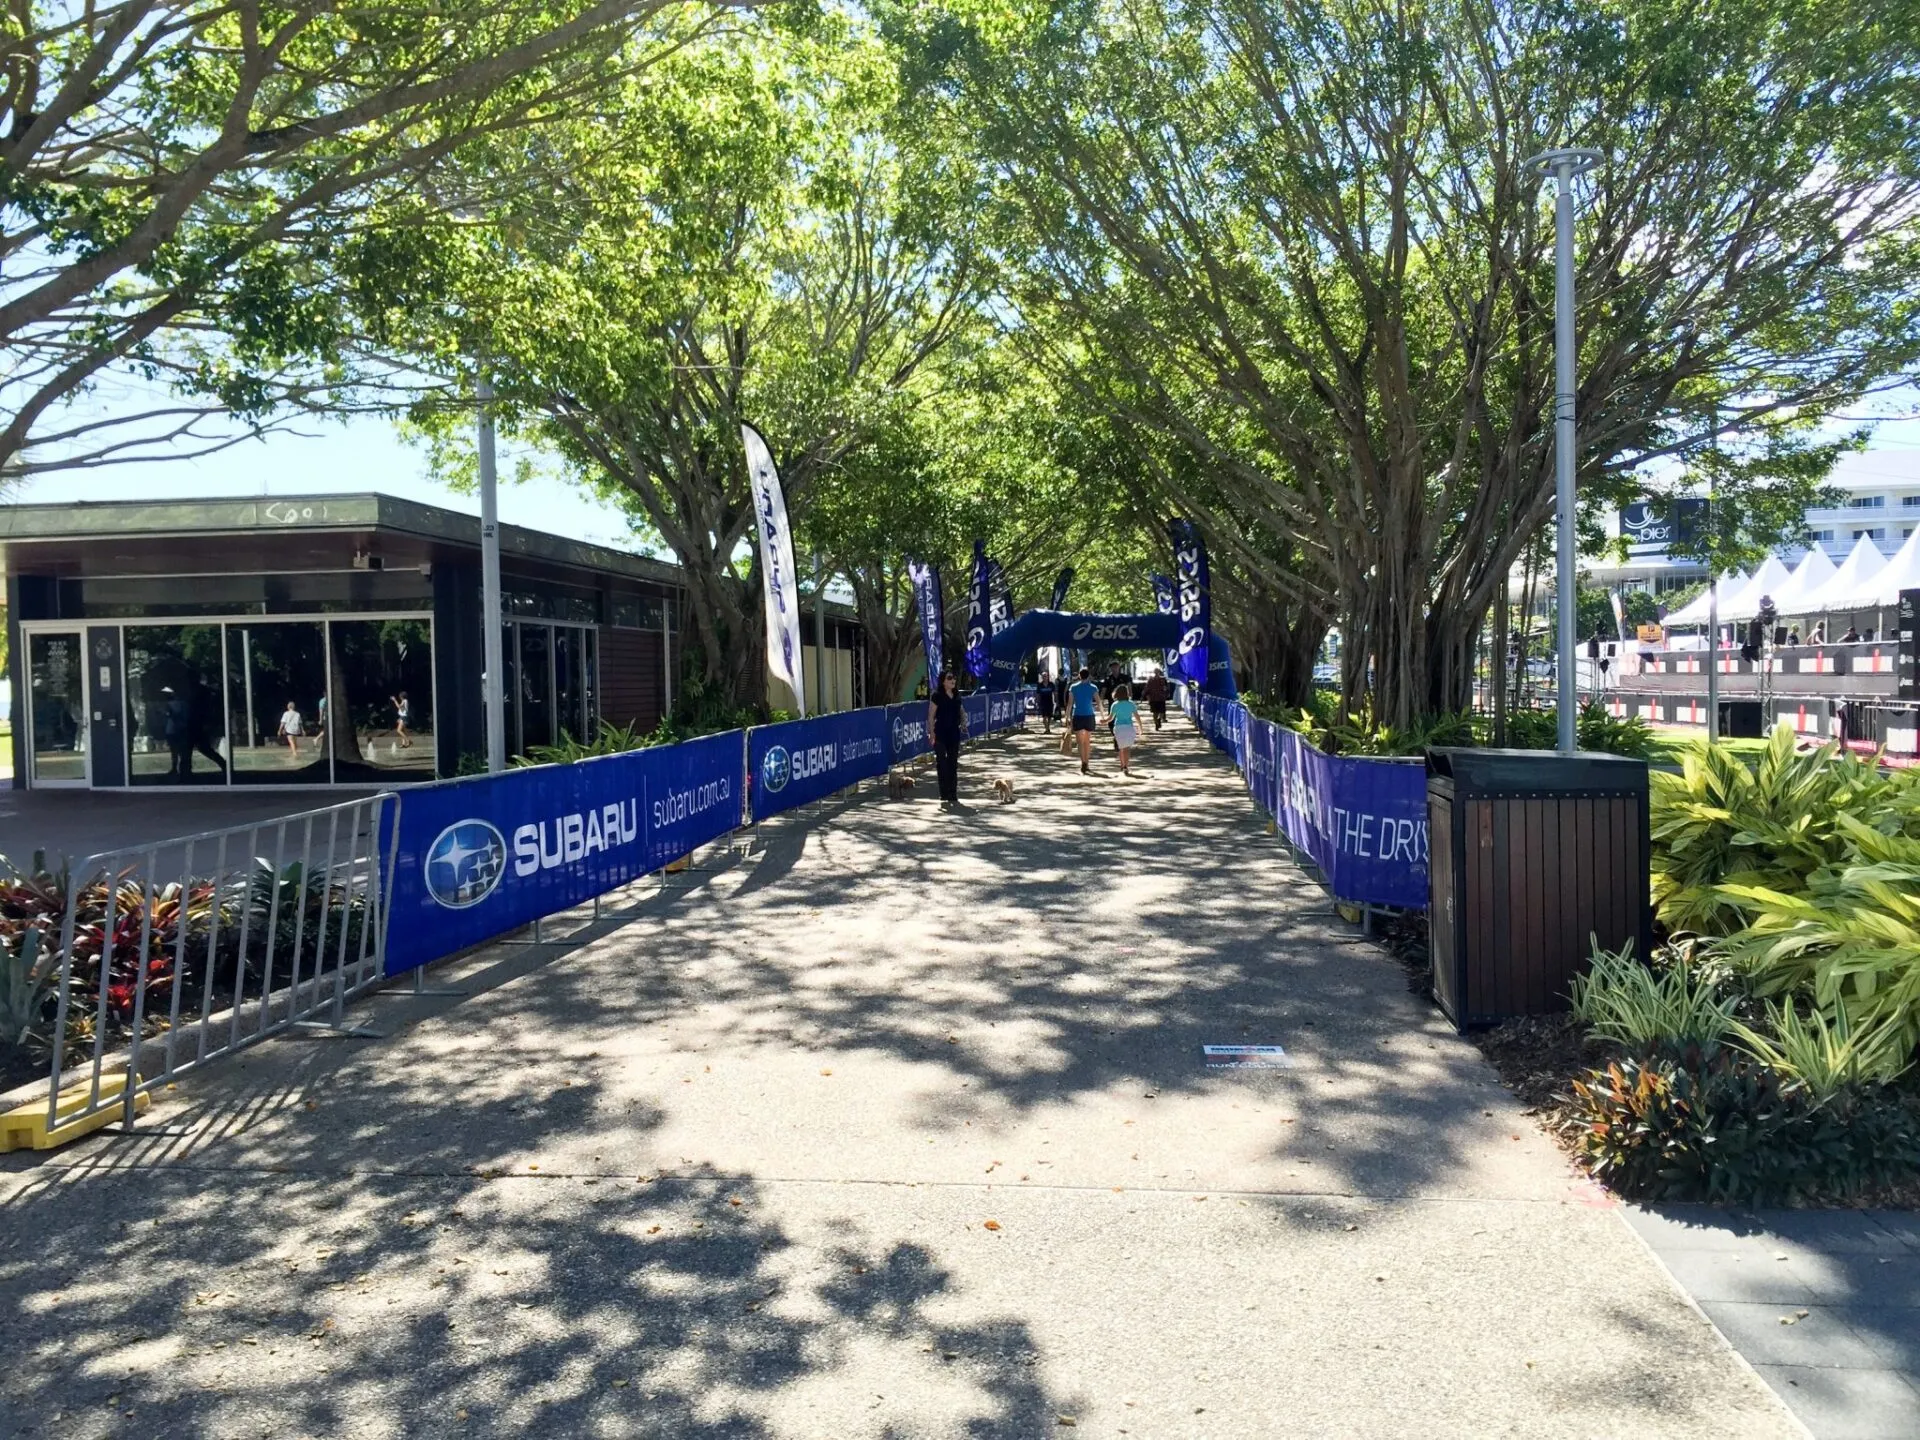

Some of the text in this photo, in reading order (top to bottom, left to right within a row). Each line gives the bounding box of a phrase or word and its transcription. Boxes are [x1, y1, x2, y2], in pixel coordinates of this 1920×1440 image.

[792, 742, 838, 781] SUBARU
[513, 775, 731, 878] SUBARU subaru.com.au
[1334, 807, 1374, 858] THE
